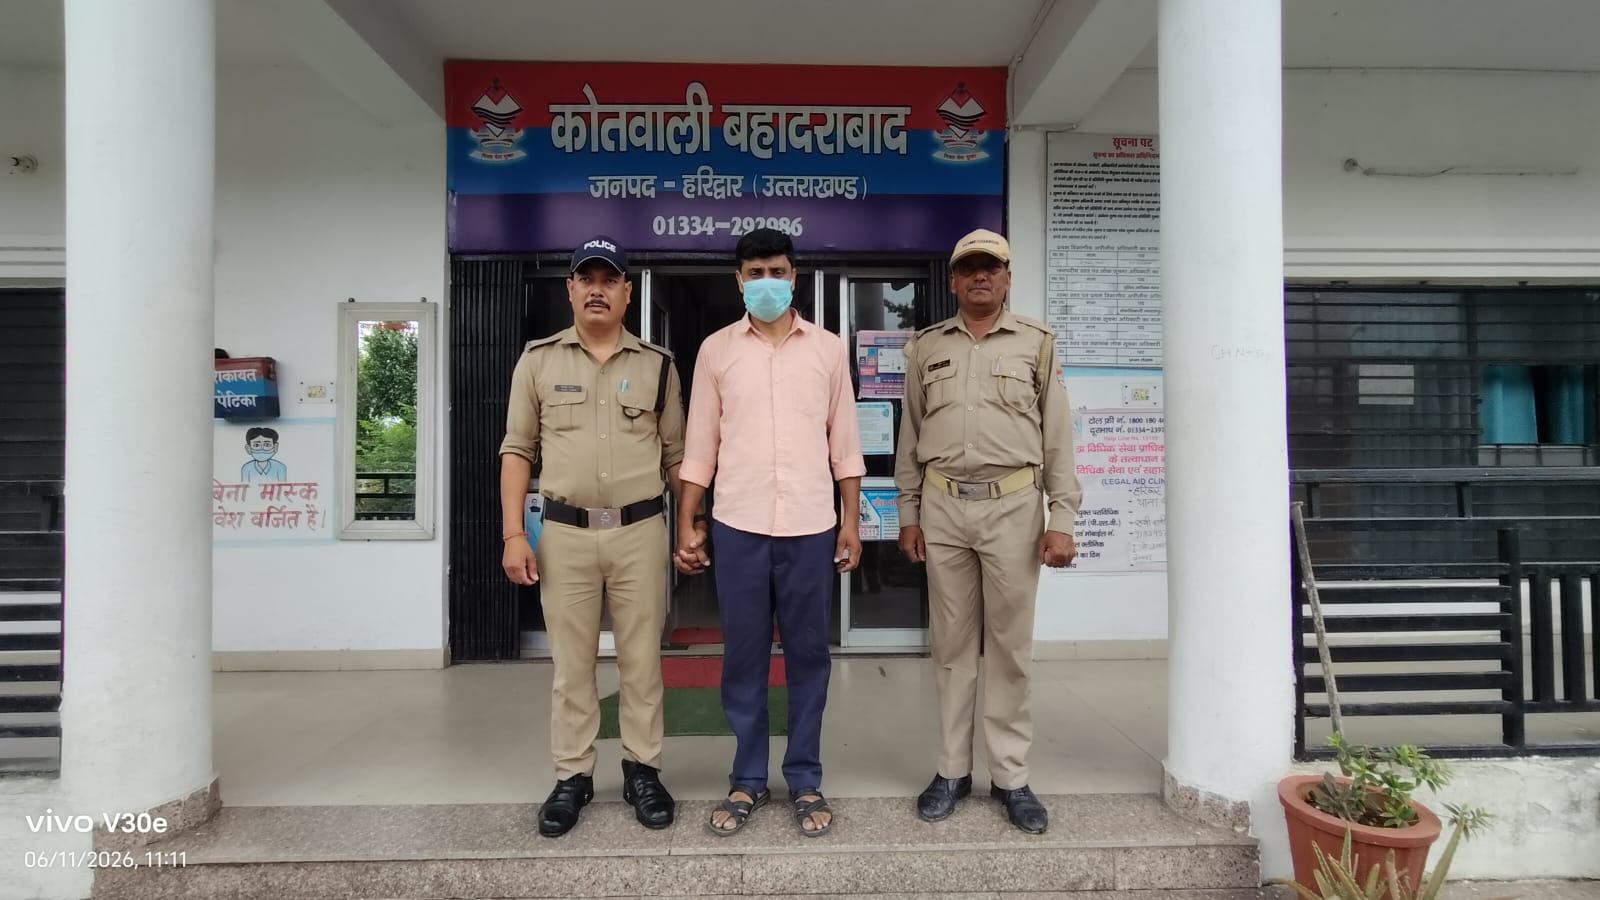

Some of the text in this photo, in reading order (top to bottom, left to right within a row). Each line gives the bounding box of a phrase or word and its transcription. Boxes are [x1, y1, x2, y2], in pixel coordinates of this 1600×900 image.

[549, 82, 911, 159] कोतवाली बहादराबाद
[1112, 137, 1138, 150] सूचना
[588, 175, 657, 199] जनपद
[682, 165, 744, 199] हरिद्वार
[584, 240, 616, 253] POLICE
[215, 390, 258, 408] पेटिका
[1088, 416, 1103, 424] टोल
[1088, 443, 1115, 452] विधिक
[1119, 443, 1136, 452] सेवा
[1108, 465, 1124, 474] सेवा
[258, 482, 319, 503] मास्क
[250, 506, 302, 530] वर्जित
